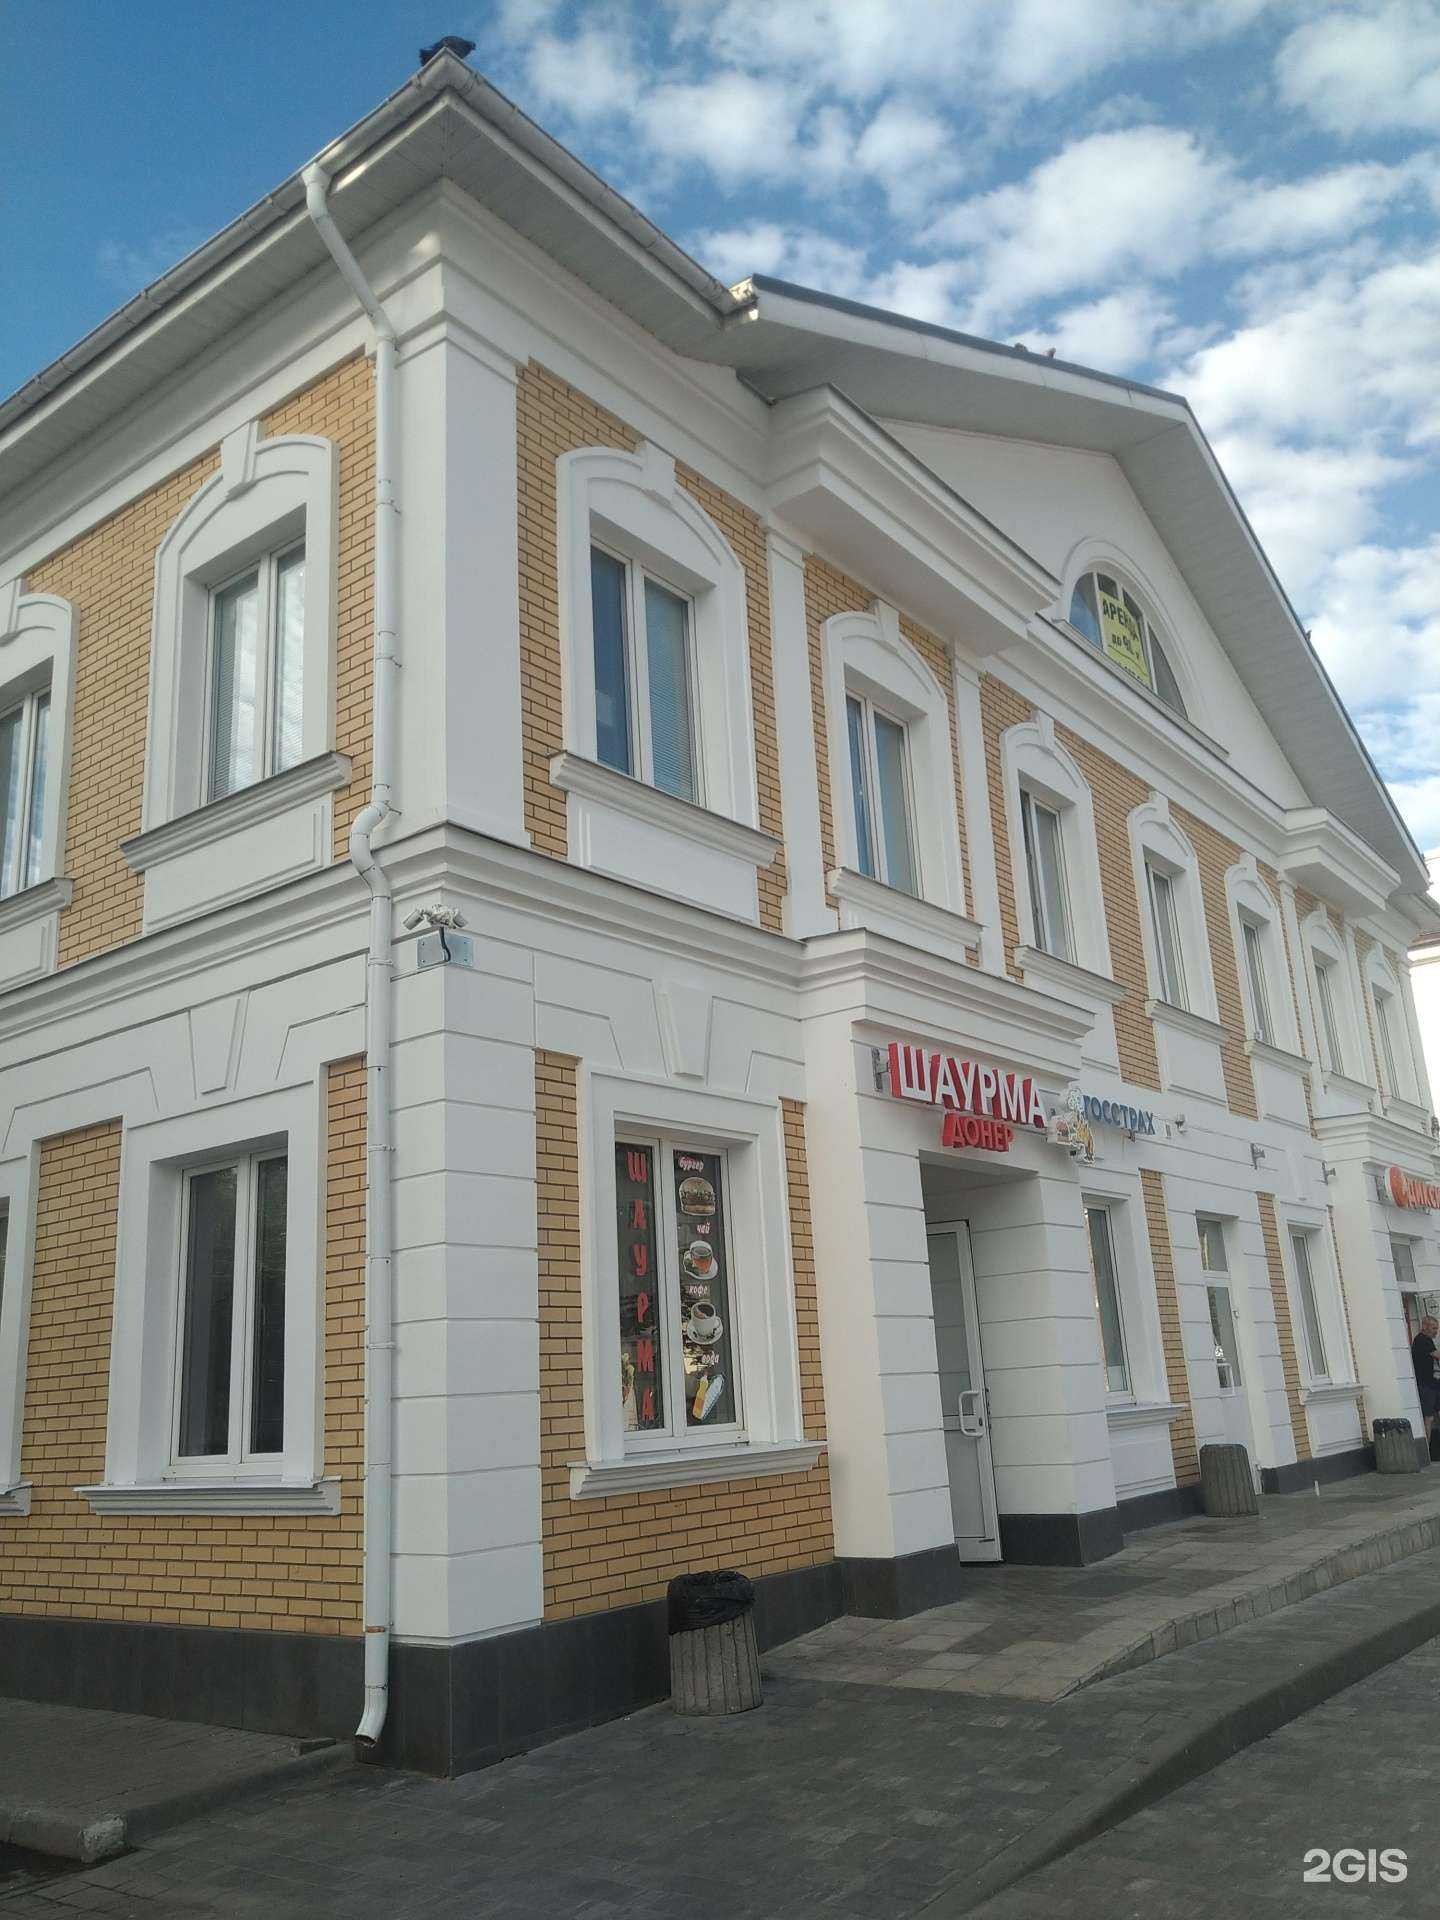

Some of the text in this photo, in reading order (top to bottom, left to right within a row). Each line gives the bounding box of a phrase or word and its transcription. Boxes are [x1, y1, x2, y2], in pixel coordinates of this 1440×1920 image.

[889, 1042, 1048, 1128] ШАУРМА
[942, 1112, 1014, 1152] ДОНЕР
[696, 1221, 711, 1235] чай
